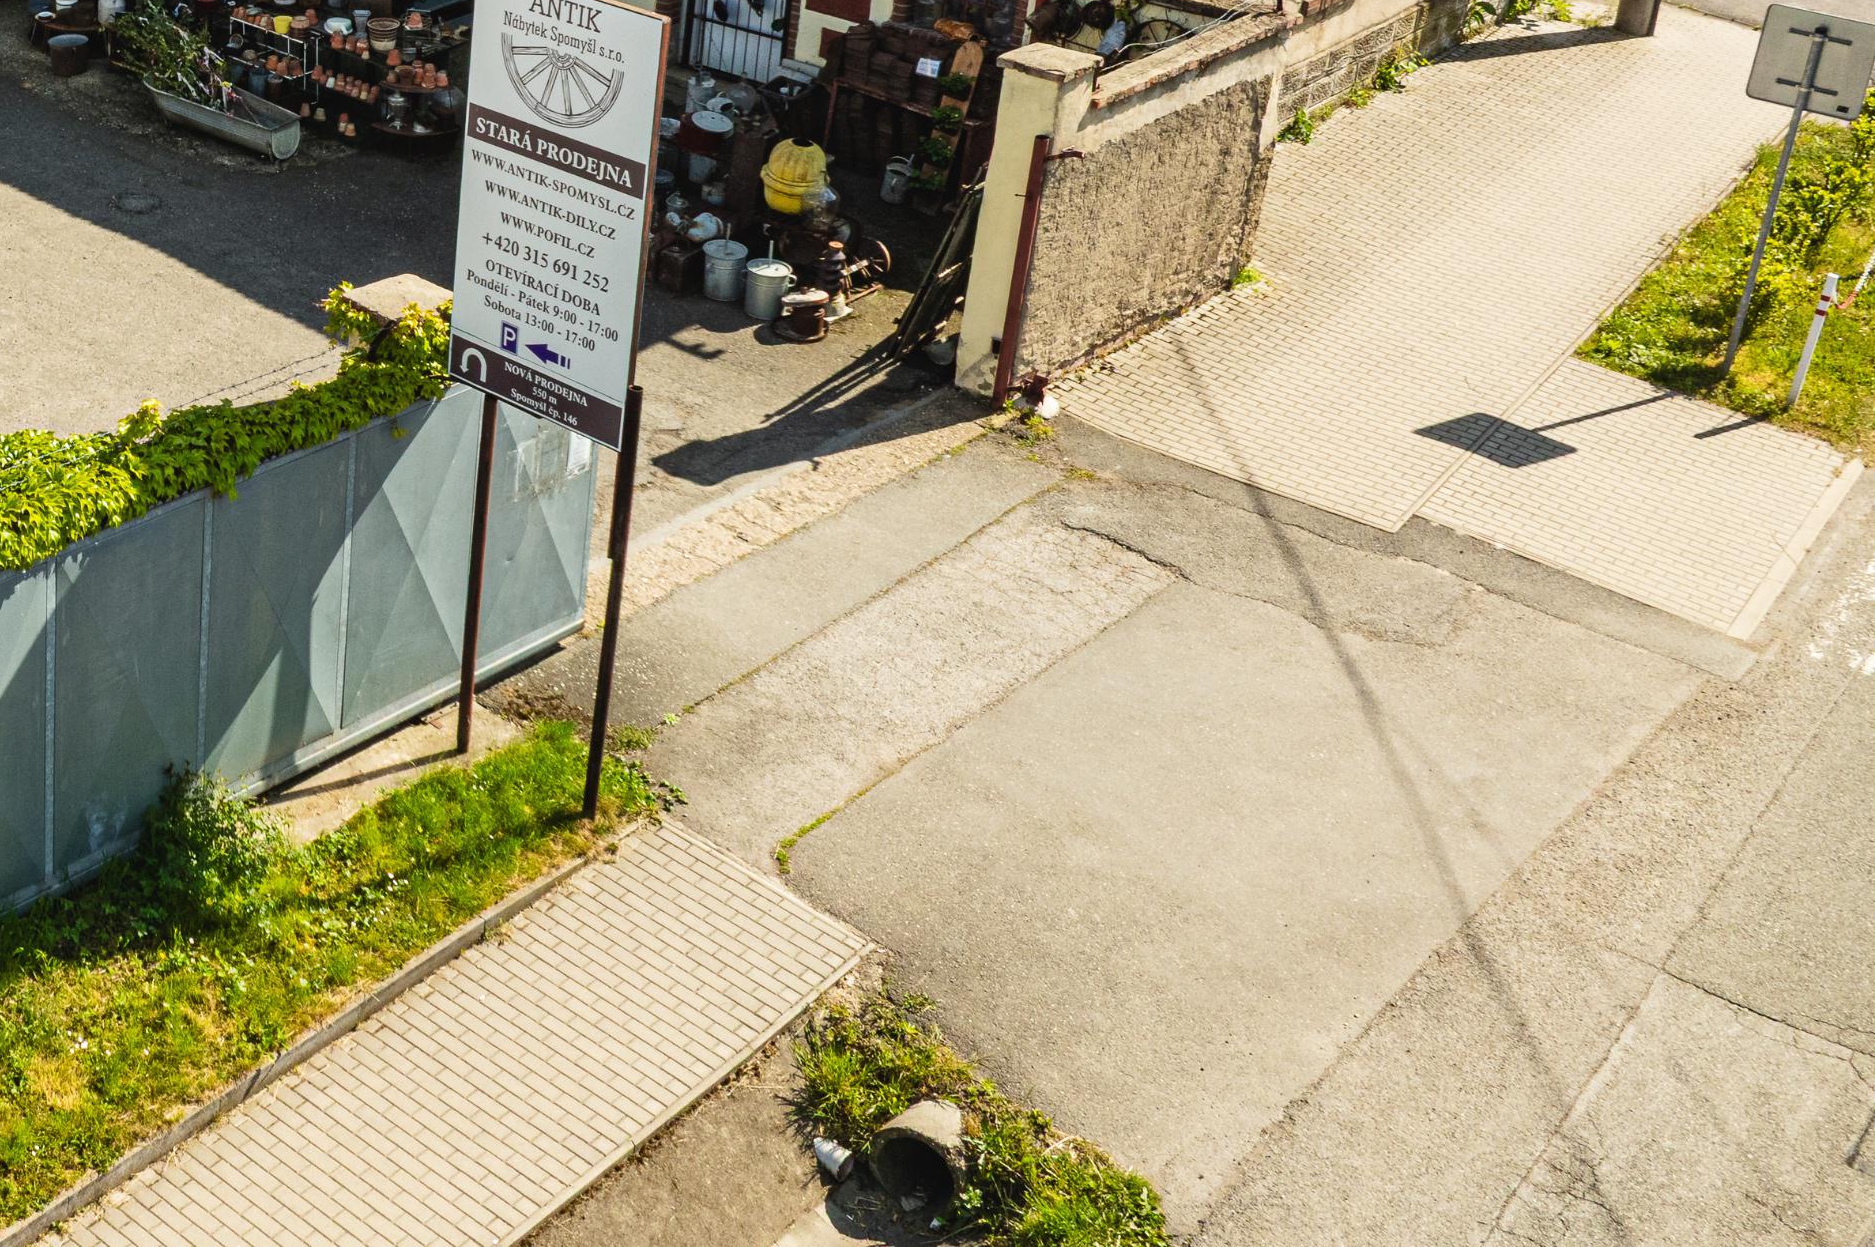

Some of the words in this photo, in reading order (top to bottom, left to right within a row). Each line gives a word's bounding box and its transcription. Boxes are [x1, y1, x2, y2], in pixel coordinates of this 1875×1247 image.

[503, 11, 548, 39] Nábytek
[551, 28, 597, 56] Spomyšl
[599, 47, 624, 63] s.r.o.
[476, 117, 532, 150] STARÁ
[537, 140, 632, 187] PRODEJNA
[472, 149, 635, 220] WWW.ANTIK-SPOMYSL.CZ
[485, 180, 616, 240] WWW.ANTIK-DILY.CZ
[482, 233, 519, 256] +420
[524, 247, 548, 268] 315
[553, 259, 577, 280] 691
[583, 271, 609, 292] 252
[501, 212, 595, 258] WWW.POFIL.CZ
[467, 269, 509, 296] Pondělí
[518, 291, 550, 313] Pátek
[553, 306, 577, 324] 9:00
[589, 317, 618, 341] 17:00
[486, 259, 558, 298] OTEVÍRACÍ
[562, 291, 600, 316] DOBA
[484, 295, 521, 320] Sobota
[525, 312, 554, 334] 13:00
[566, 329, 595, 351] 17:00
[503, 327, 516, 346] P
[505, 362, 532, 381] NOVÁ
[535, 375, 588, 407] PRODEJNA
[511, 388, 546, 413] Spomyšl
[564, 412, 577, 426] 146
[532, 386, 548, 400] 550
[548, 396, 557, 405] m
